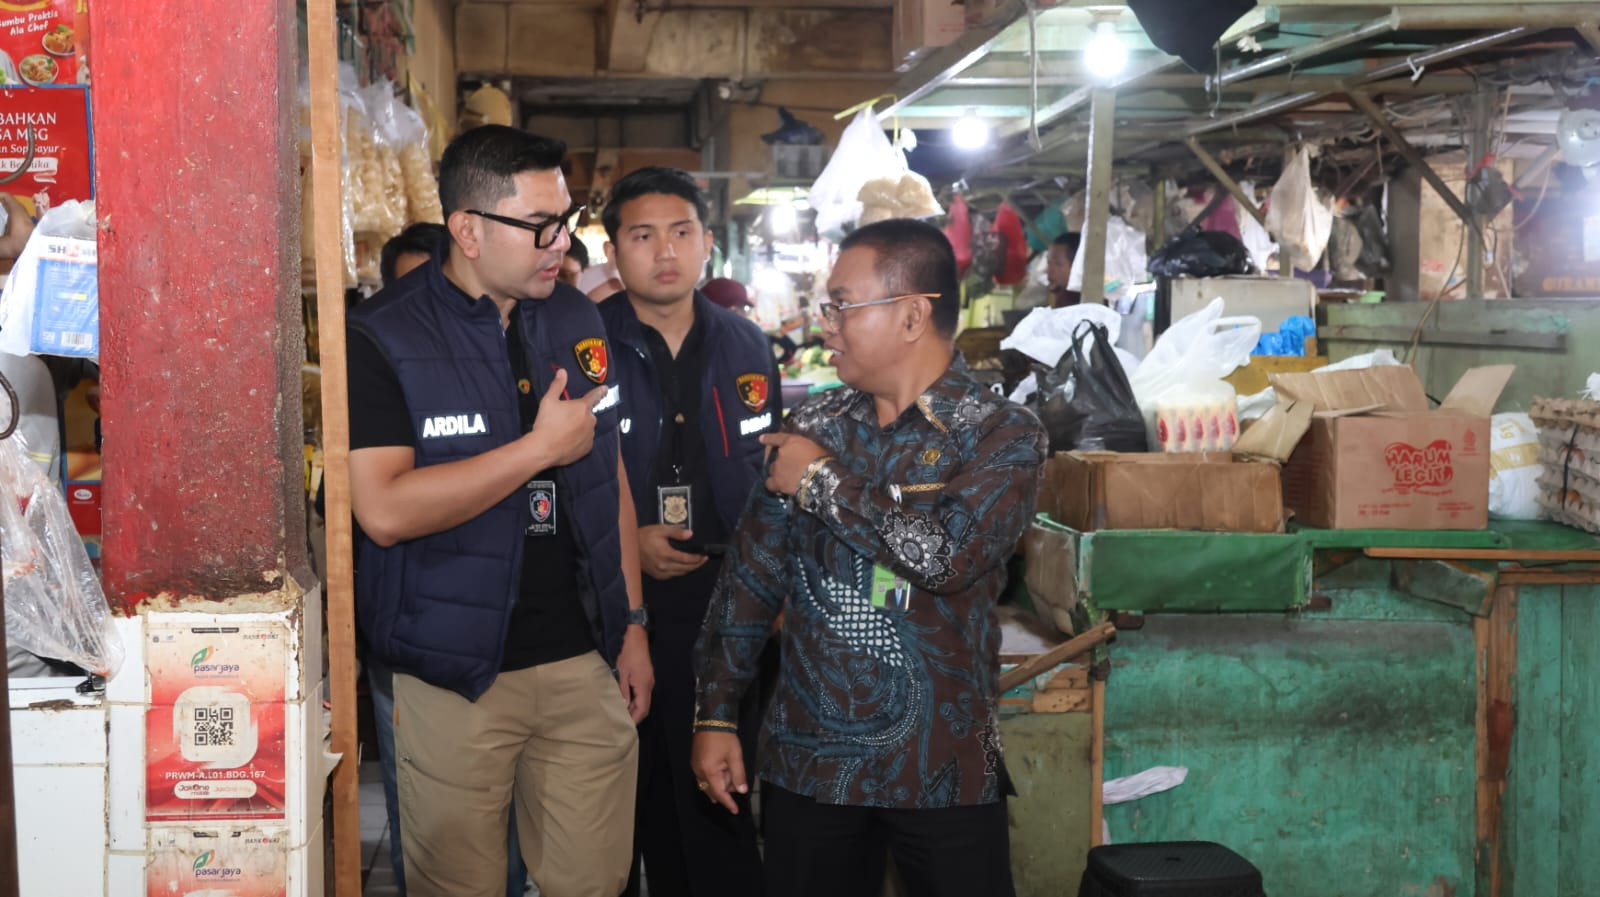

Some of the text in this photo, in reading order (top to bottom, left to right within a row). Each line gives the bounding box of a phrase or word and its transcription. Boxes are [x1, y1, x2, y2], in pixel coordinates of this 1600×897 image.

[0, 10, 58, 27] umbu Praktis
[10, 20, 49, 36] Ala Chef
[422, 413, 487, 438] ARDILA
[1384, 447, 1451, 468] HARUM
[1394, 465, 1447, 485] LEGIT
[195, 867, 242, 878] pasar jaya
